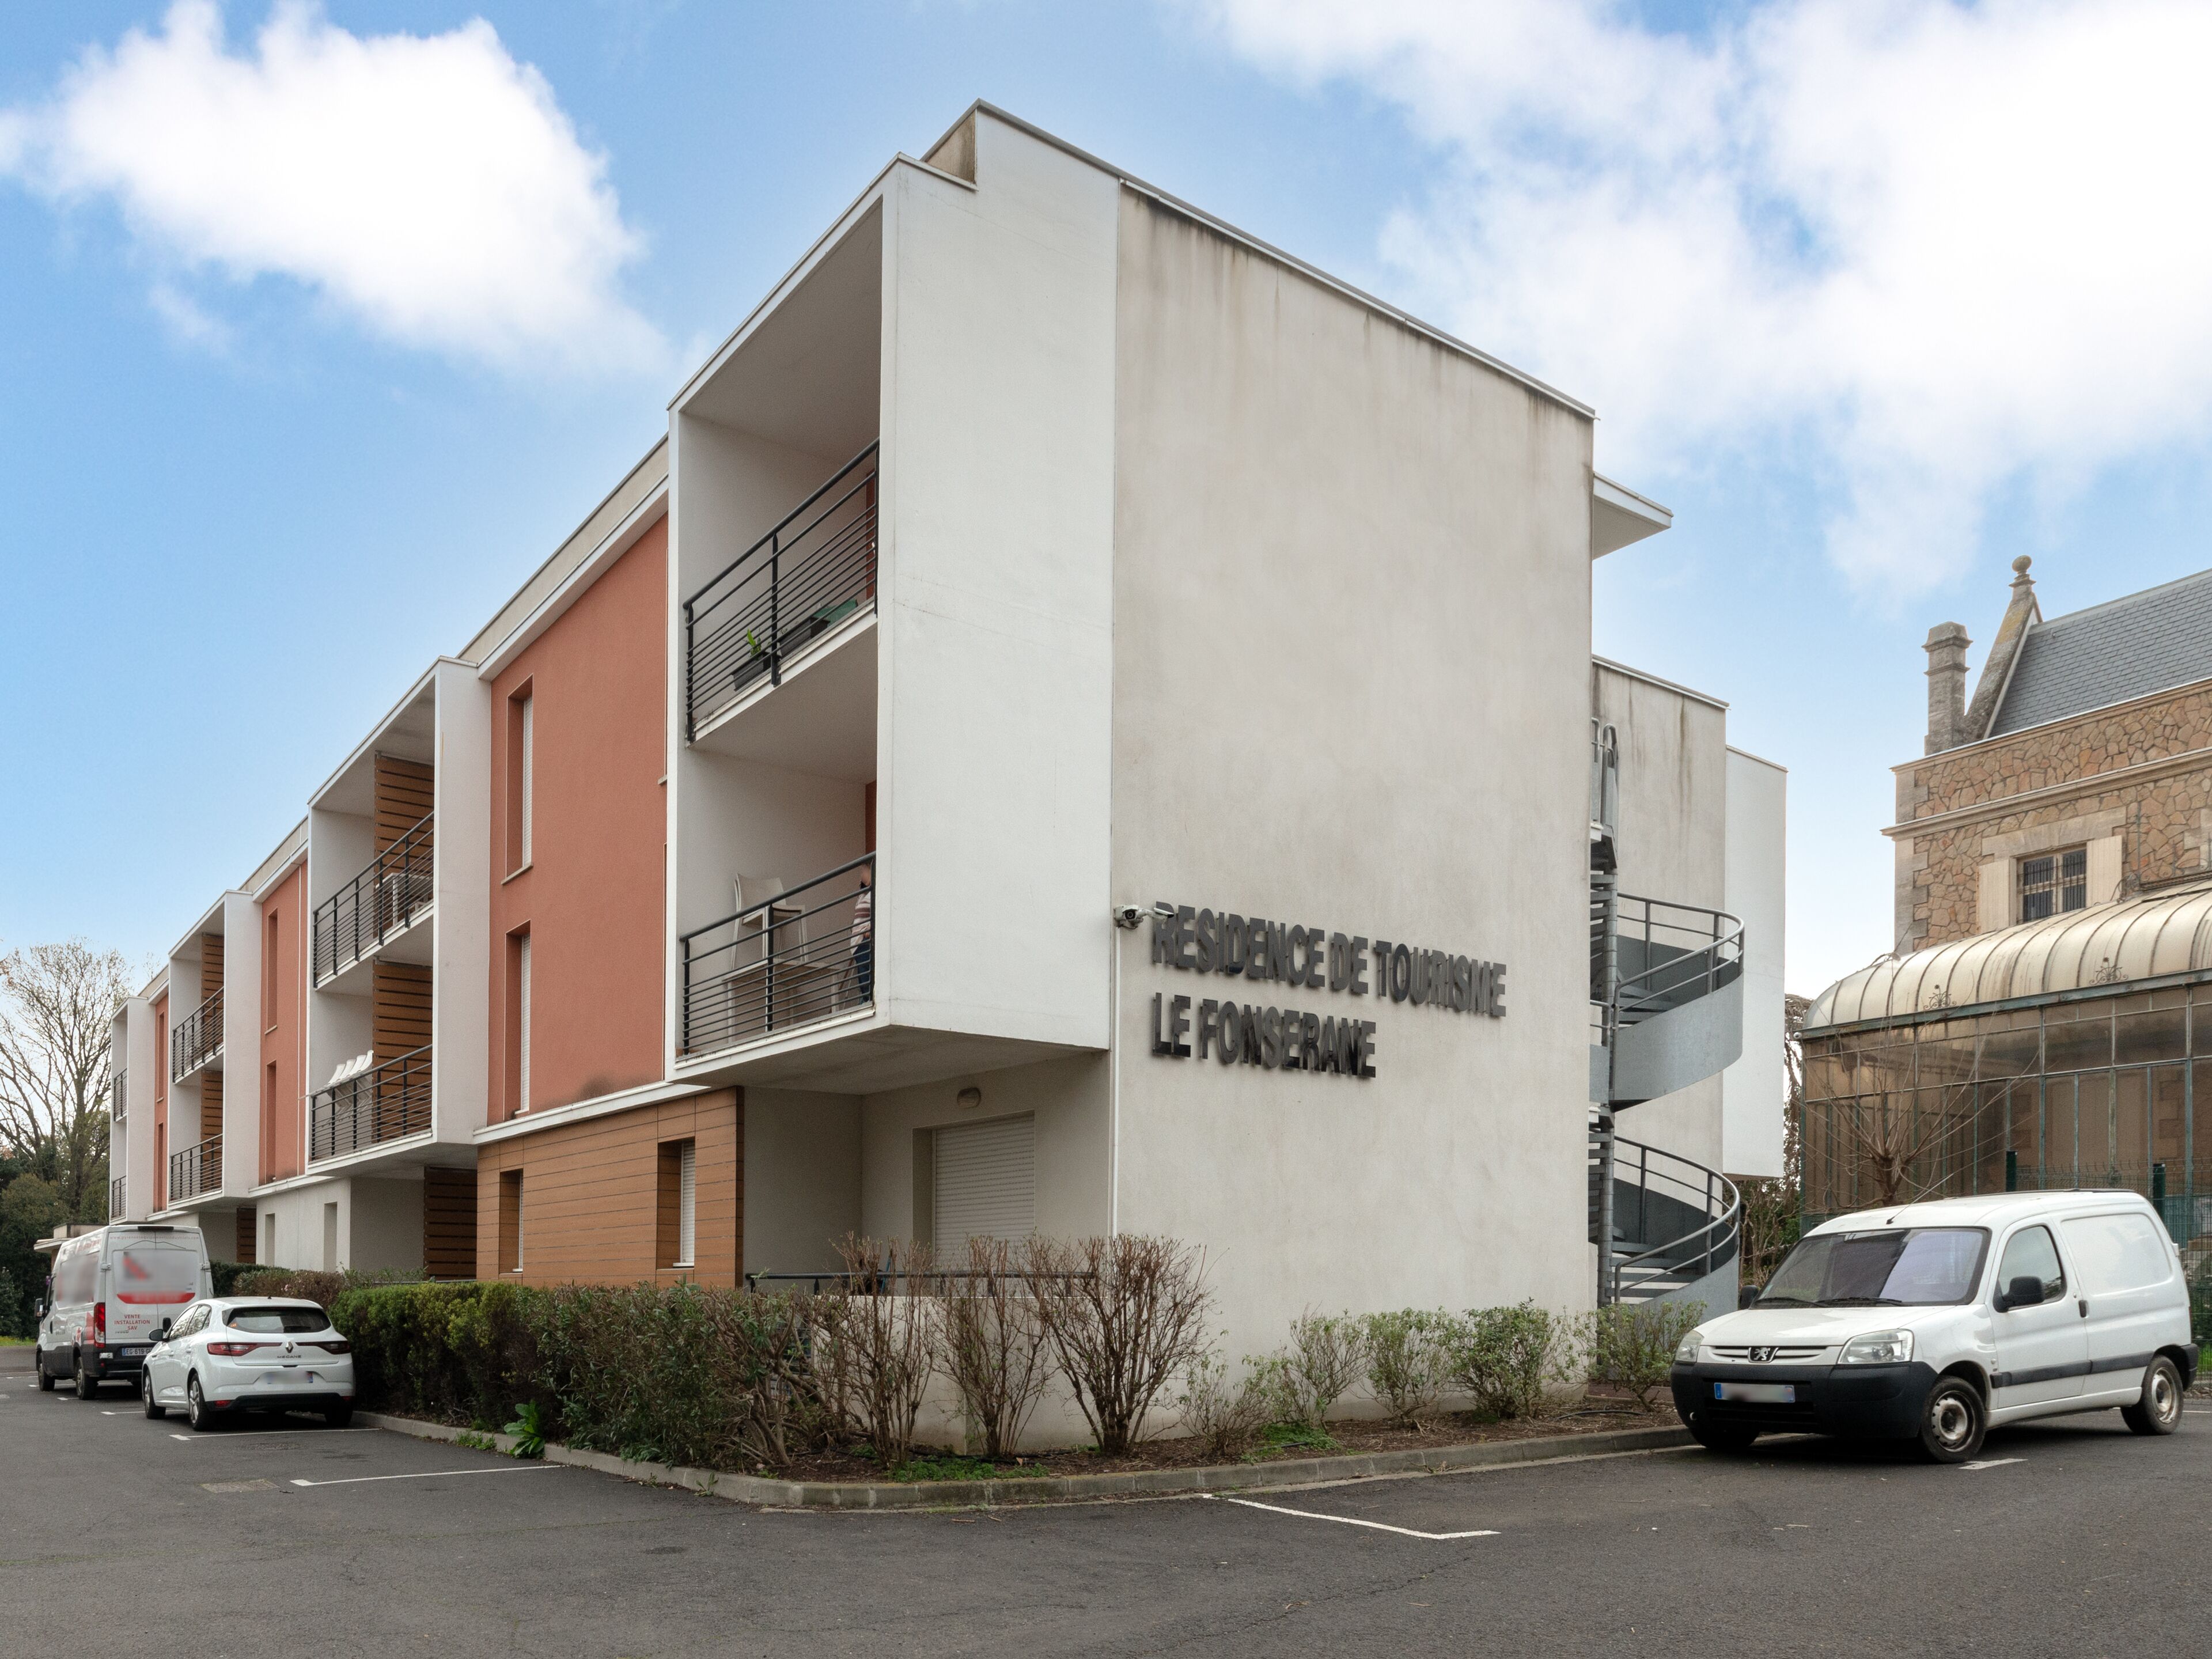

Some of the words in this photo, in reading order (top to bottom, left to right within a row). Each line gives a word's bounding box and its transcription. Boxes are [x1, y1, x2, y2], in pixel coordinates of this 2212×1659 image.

[1154, 901, 1325, 987] RESIDENCE
[1332, 931, 1369, 994] DE
[1375, 940, 1507, 1017] TOURISME
[1154, 992, 1191, 1058] LE
[1202, 998, 1376, 1078] FONSERANE
